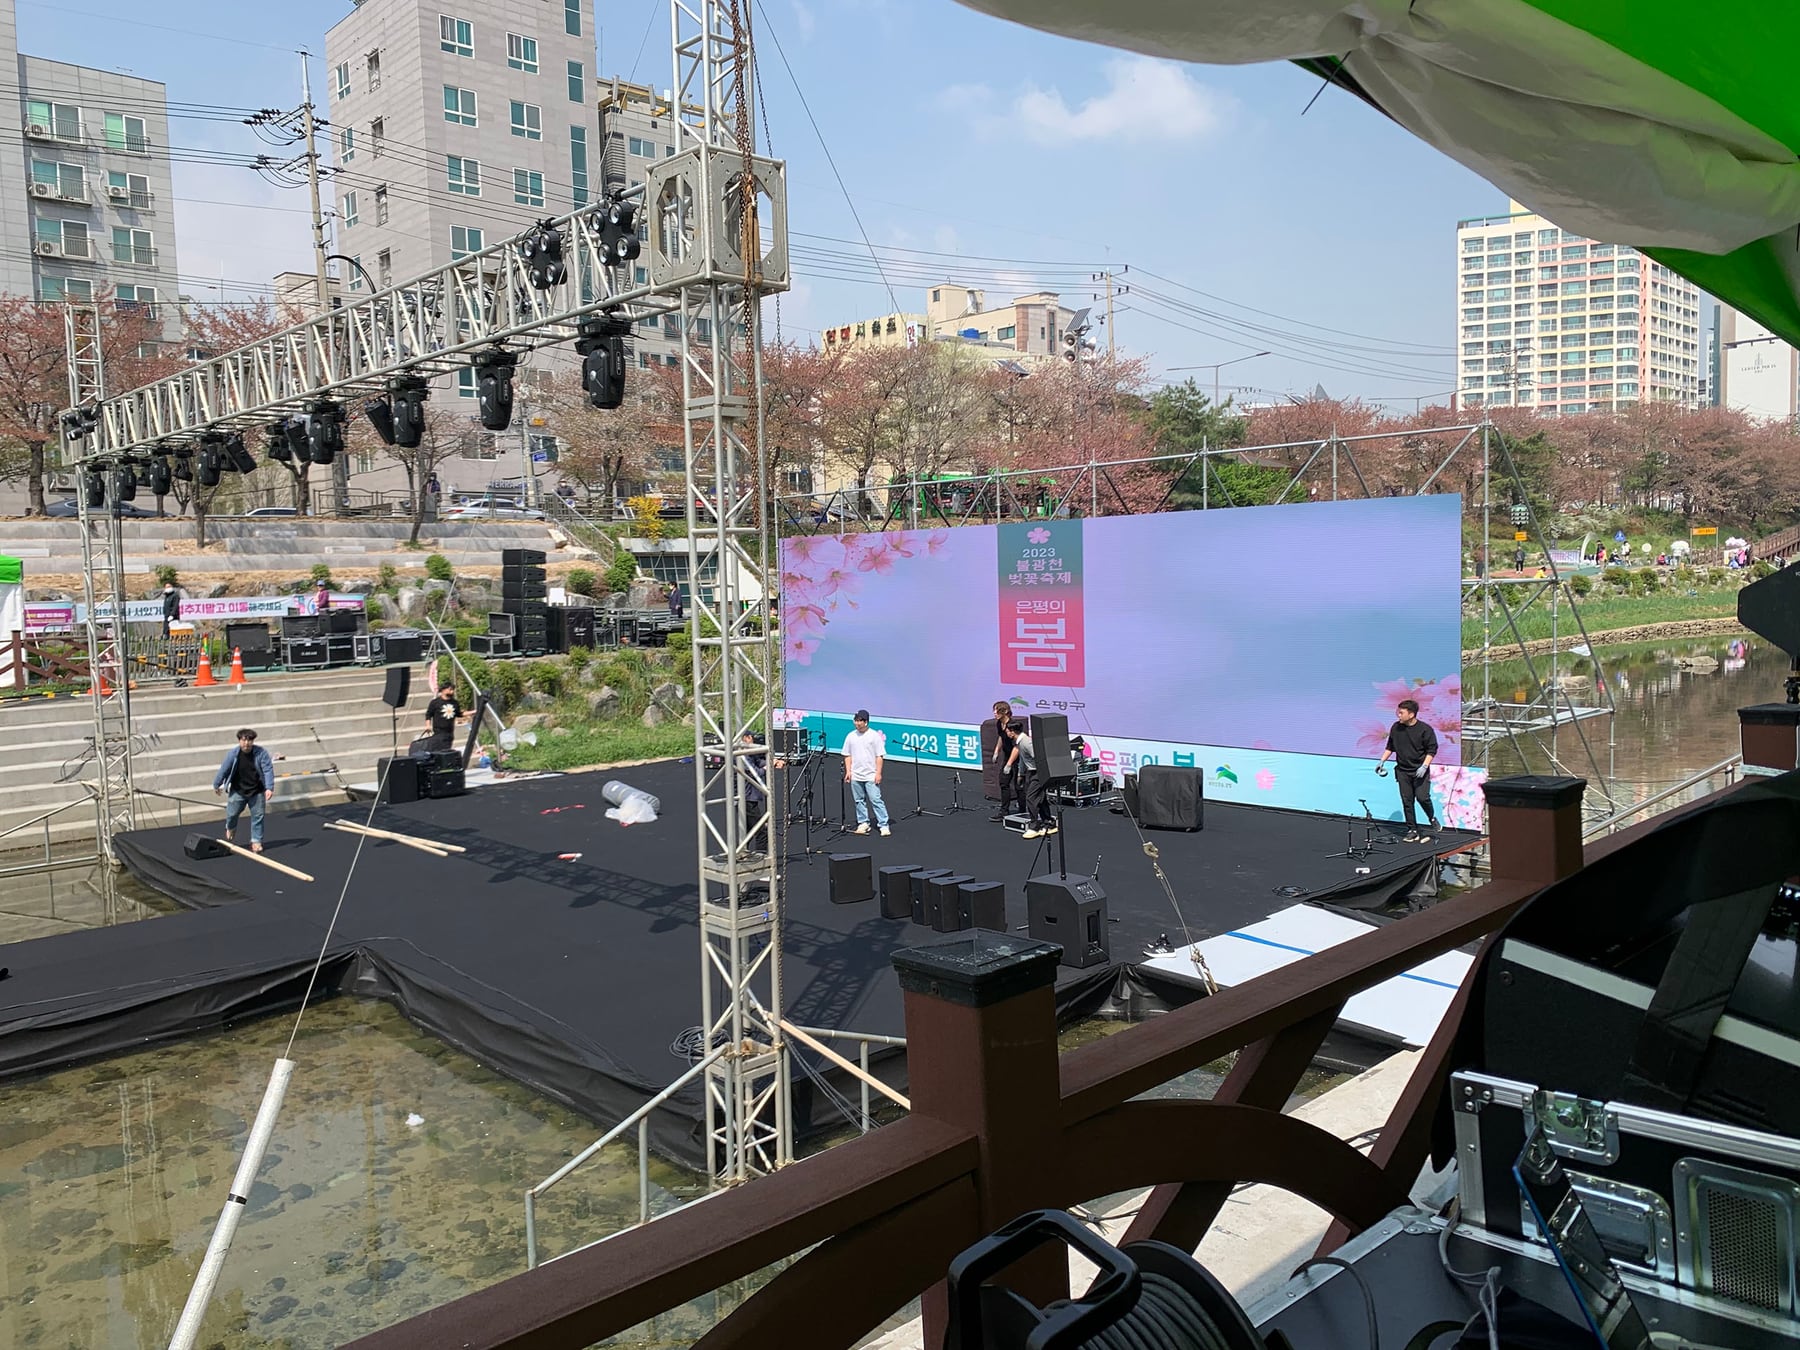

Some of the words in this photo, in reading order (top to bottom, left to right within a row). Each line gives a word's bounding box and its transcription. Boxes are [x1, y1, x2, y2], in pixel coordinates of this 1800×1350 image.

[1022, 548, 1056, 558] 2023
[1016, 558, 1063, 572] 불광천
[1008, 572, 1072, 585] 벚꽃축제
[1016, 600, 1065, 614] 은평의
[1008, 618, 1075, 673] 봄
[902, 732, 938, 754] 2023
